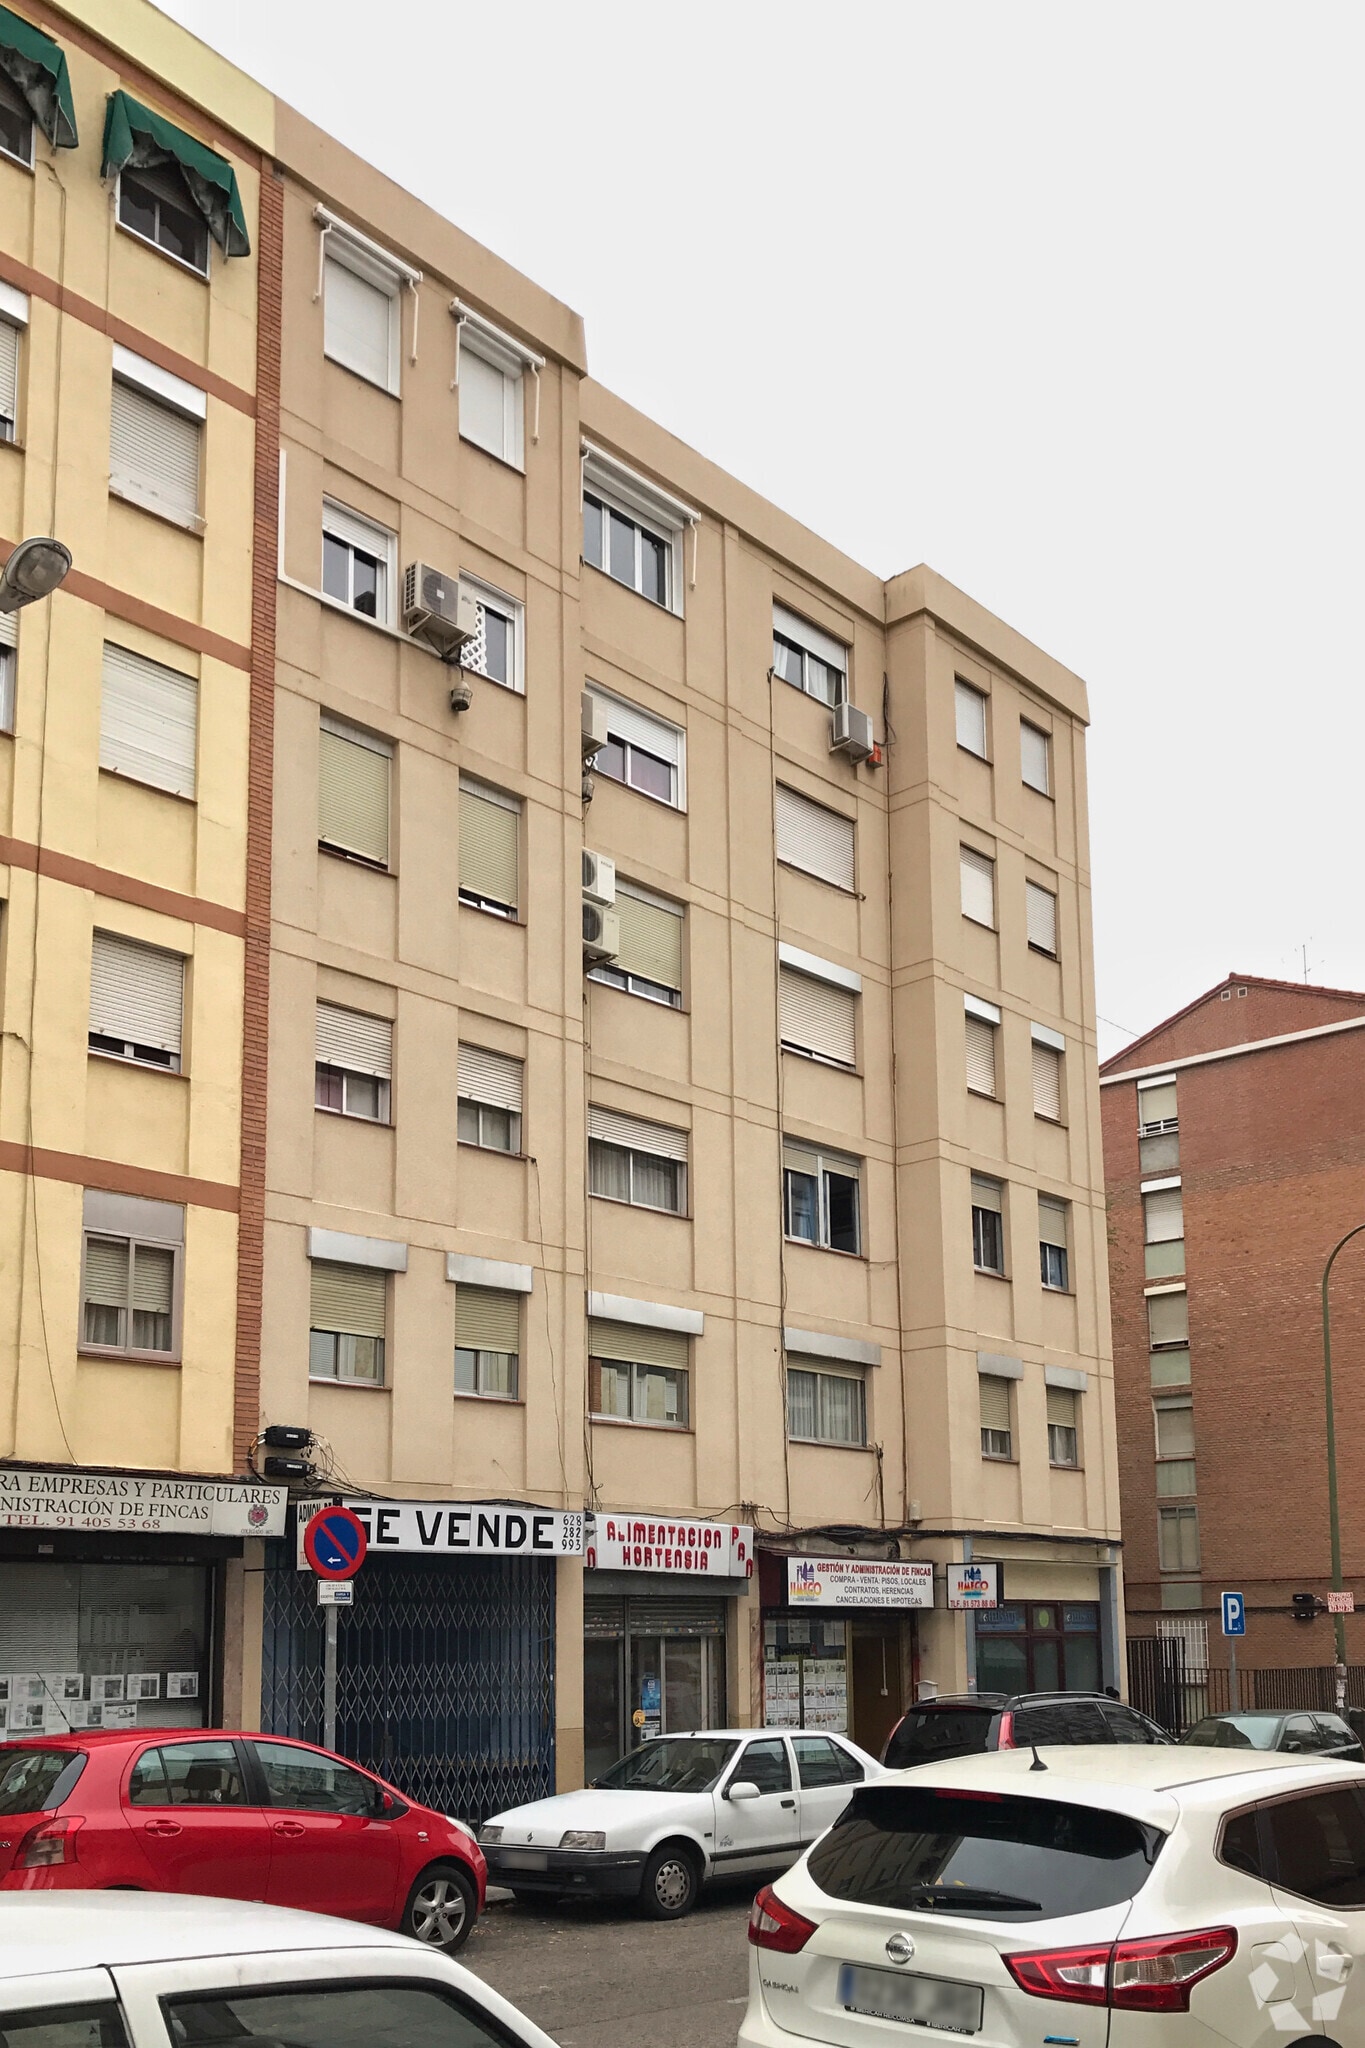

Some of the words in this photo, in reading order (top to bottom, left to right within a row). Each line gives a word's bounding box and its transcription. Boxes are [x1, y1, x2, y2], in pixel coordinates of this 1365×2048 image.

[28, 1476, 129, 1497] EMPRESAS
[134, 1481, 146, 1497] Y
[151, 1482, 281, 1505] PARTICULARES
[0, 1496, 114, 1515] NISTRACIÓN
[120, 1501, 144, 1516] DE
[148, 1503, 209, 1519] FINCAS
[2, 1513, 50, 1526] TEL.
[56, 1516, 75, 1527] 91
[81, 1517, 111, 1528] 405
[117, 1518, 136, 1529] 53
[141, 1520, 160, 1529] 68
[563, 1514, 582, 1527] 628
[415, 1509, 554, 1549] VENDE
[563, 1527, 582, 1539] 282
[606, 1520, 722, 1549] ALIMENTACION
[561, 1539, 582, 1551] 993
[622, 1545, 709, 1571] HORTENSIA
[816, 1562, 844, 1574] GESTIÓN
[845, 1563, 850, 1574] Y
[851, 1564, 900, 1576] ADMINISTRACIÓN
[901, 1566, 909, 1576] DE
[911, 1567, 932, 1577] FINCAS
[829, 1575, 856, 1583] COMPRA
[900, 1578, 927, 1586] LOCALES
[881, 1587, 914, 1595] HERENCIAS
[835, 1595, 886, 1605] CANCELACIONES
[890, 1597, 923, 1605] HIPOTECAS
[1227, 1597, 1241, 1631] P
